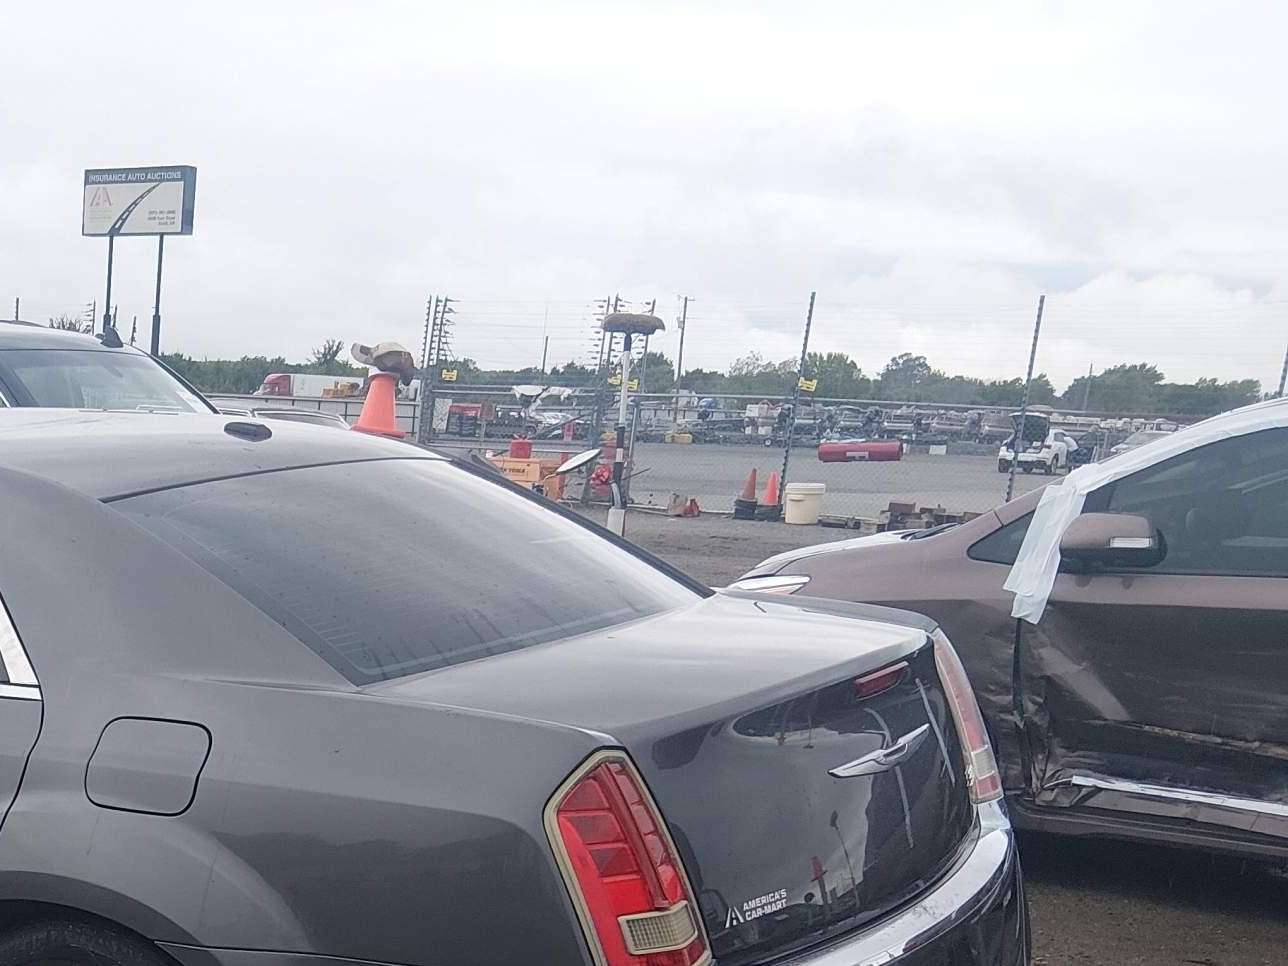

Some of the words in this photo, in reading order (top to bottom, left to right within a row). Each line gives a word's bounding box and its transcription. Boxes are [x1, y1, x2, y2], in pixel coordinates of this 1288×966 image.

[88, 173, 126, 183] INSURANCE
[128, 172, 145, 181] AUTO
[147, 171, 182, 180] AUCTIONS
[742, 888, 787, 911] AMERICA'S
[745, 898, 787, 921] CAR-MART
